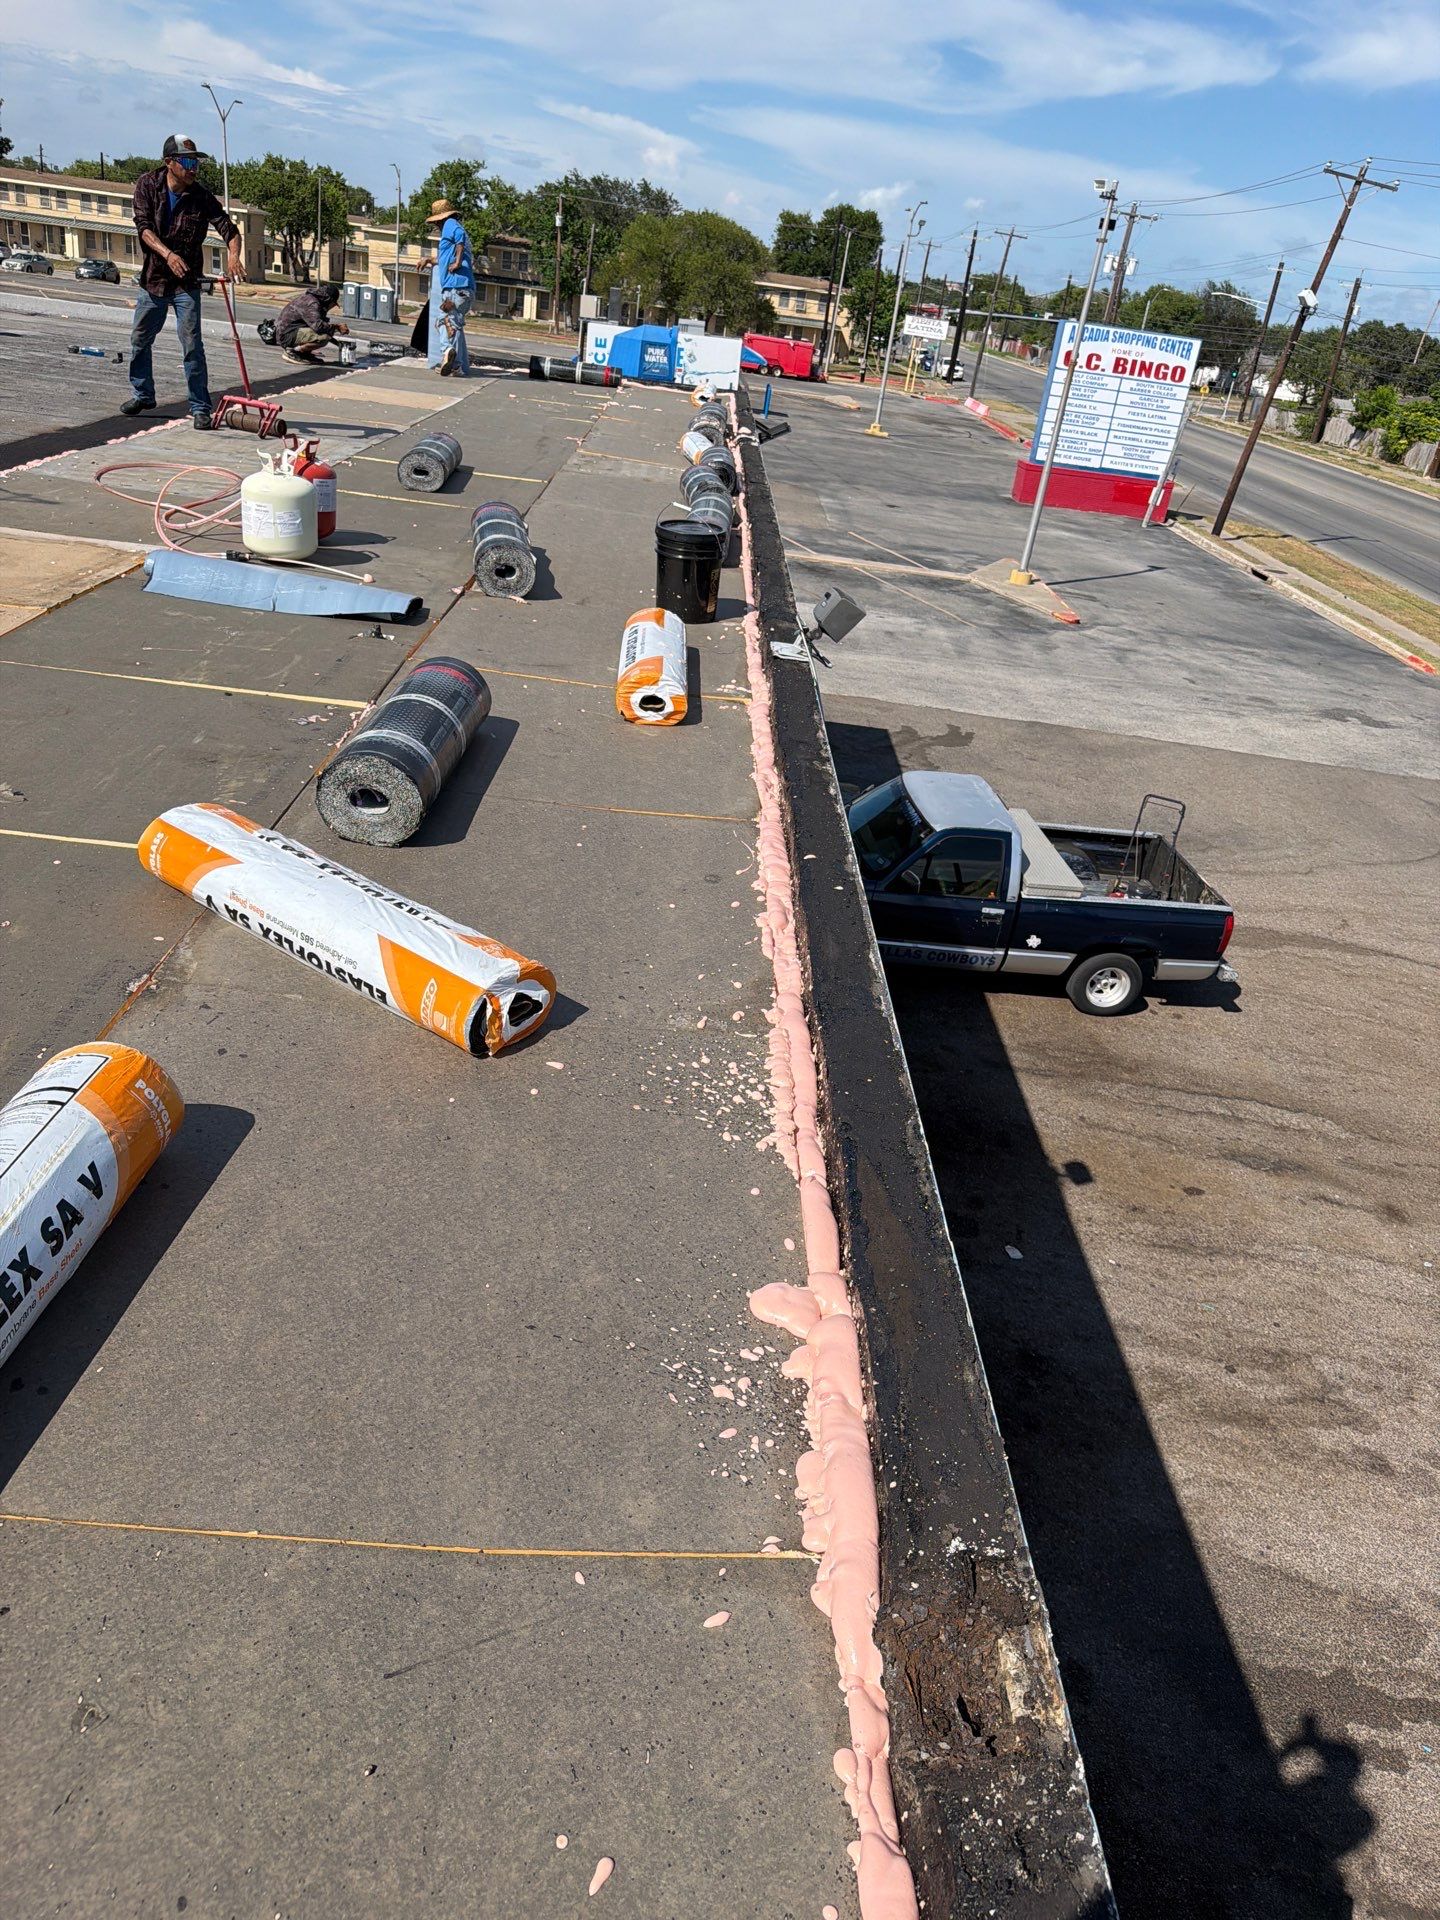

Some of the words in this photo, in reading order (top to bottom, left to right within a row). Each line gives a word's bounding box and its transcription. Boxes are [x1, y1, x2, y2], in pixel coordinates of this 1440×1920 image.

[908, 324, 943, 334] LATINA
[647, 347, 665, 356] PURE
[1068, 325, 1109, 344] ACADIA
[1112, 330, 1157, 349] SHOPPING
[1159, 337, 1194, 361] CENTER
[1112, 348, 1131, 356] HOME
[644, 355, 668, 364] WATER
[1112, 356, 1186, 384] BINGO
[1139, 396, 1164, 404] GARCIA'S
[1117, 422, 1153, 431] FISHERMAN'S
[1113, 434, 1143, 443] WATERMILL
[1144, 438, 1169, 446] EXPRESS
[204, 893, 220, 915] V
[228, 889, 249, 911] Sheet
[248, 902, 266, 919] Base
[224, 902, 251, 930] SA
[265, 913, 301, 937] Membrane
[300, 931, 314, 946] SBS
[257, 923, 388, 1006] ELASTOFLEX
[314, 939, 359, 970] Self-Adhered
[40, 1198, 85, 1258] SA
[77, 1160, 104, 1200] V
[0, 1299, 37, 1353] embrane
[38, 1276, 59, 1301] Base
[60, 1237, 84, 1271] Sheet
